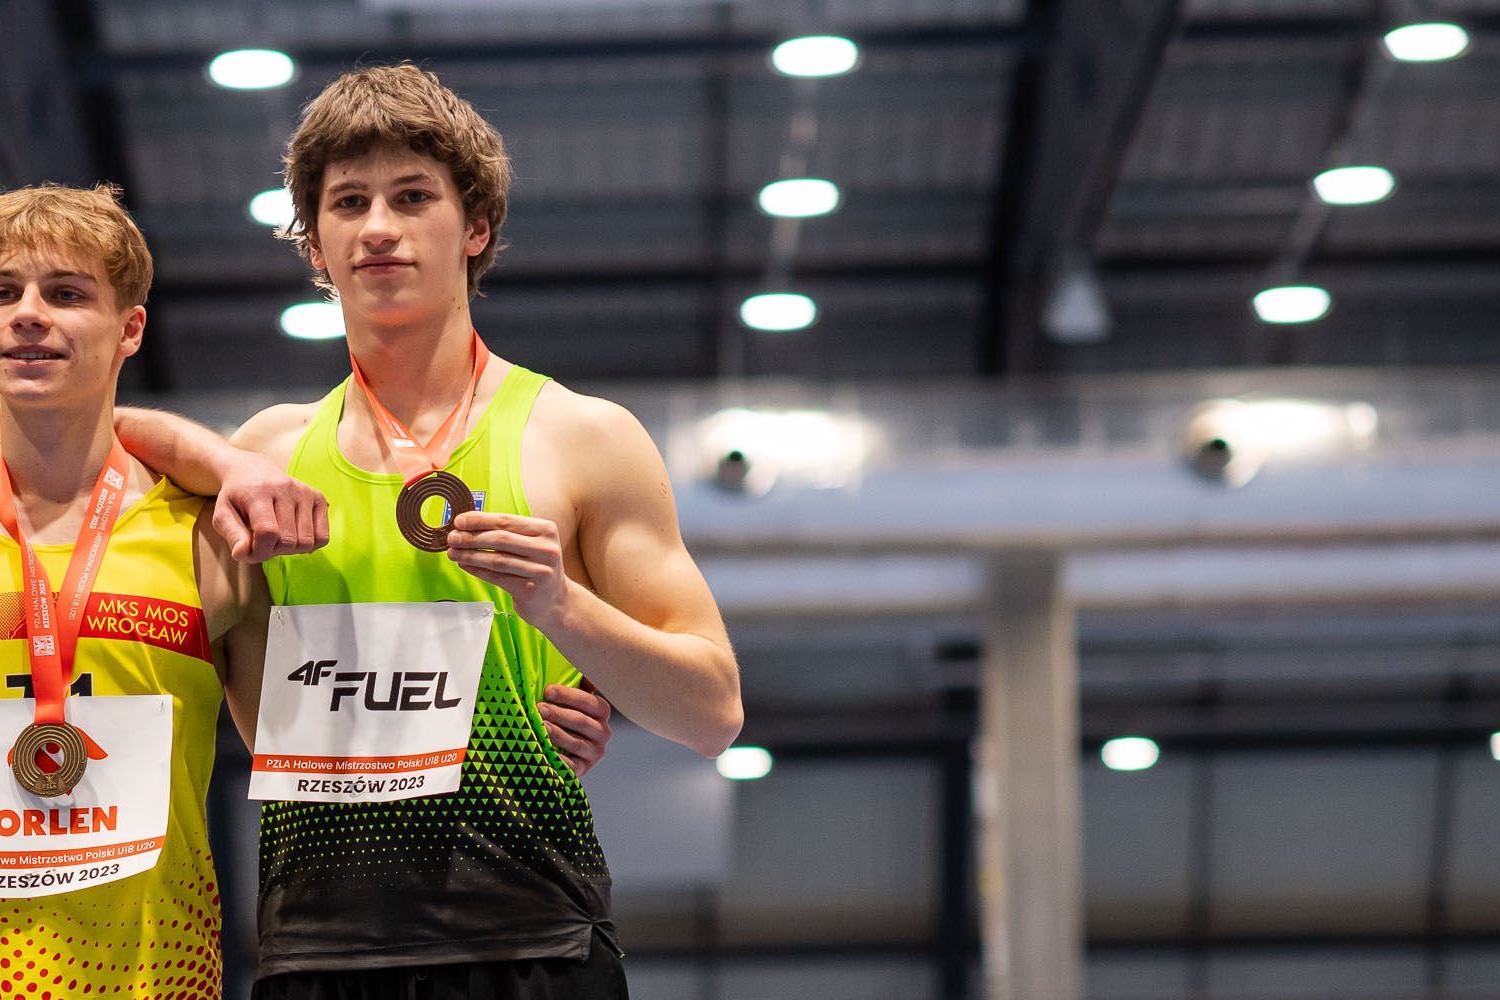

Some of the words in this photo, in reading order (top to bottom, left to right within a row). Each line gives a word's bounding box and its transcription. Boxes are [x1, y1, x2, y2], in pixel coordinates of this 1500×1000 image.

[98, 599, 139, 617] MKS
[145, 603, 189, 627] MOS
[87, 615, 187, 645] WROCŁAW
[287, 659, 338, 686] 4F
[329, 671, 462, 712] FUEL
[266, 759, 291, 769] PZLA
[293, 760, 333, 770] Halowe
[335, 761, 396, 770] Mistrzostwa
[397, 759, 424, 769] Polski
[424, 755, 440, 766] U18
[440, 752, 458, 764] U20
[297, 776, 386, 794] RZESZÓW
[389, 775, 426, 793] 2023
[19, 852, 84, 865] Mistrzostwa
[85, 847, 116, 860] Polski
[117, 845, 134, 855] U18
[136, 840, 156, 852] U20
[78, 864, 120, 882] 2023
